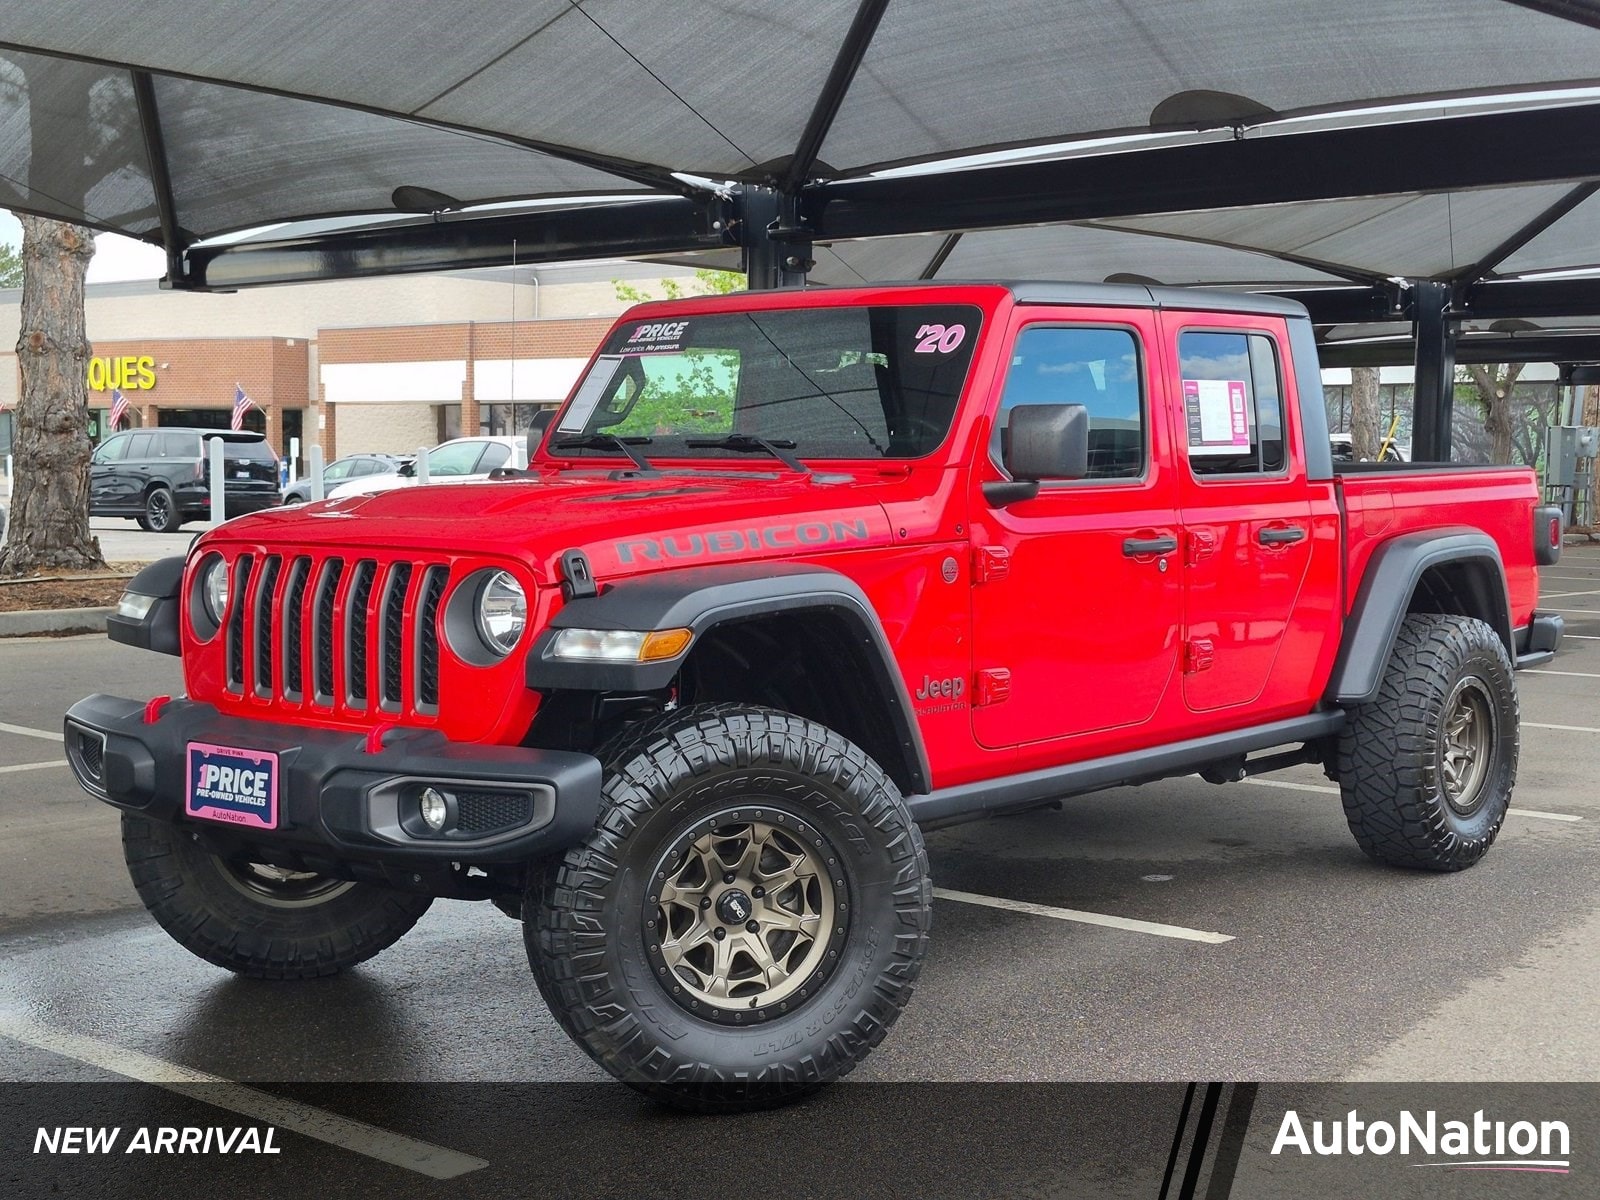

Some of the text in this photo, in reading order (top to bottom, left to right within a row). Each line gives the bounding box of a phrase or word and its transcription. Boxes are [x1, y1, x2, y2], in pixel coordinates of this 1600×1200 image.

[87, 356, 156, 392] QUES
[616, 519, 868, 564] RUBICON
[916, 675, 964, 701] Jeep
[196, 788, 267, 807] PRE-OWNED VEHICLES
[212, 810, 247, 823] AutoNation
